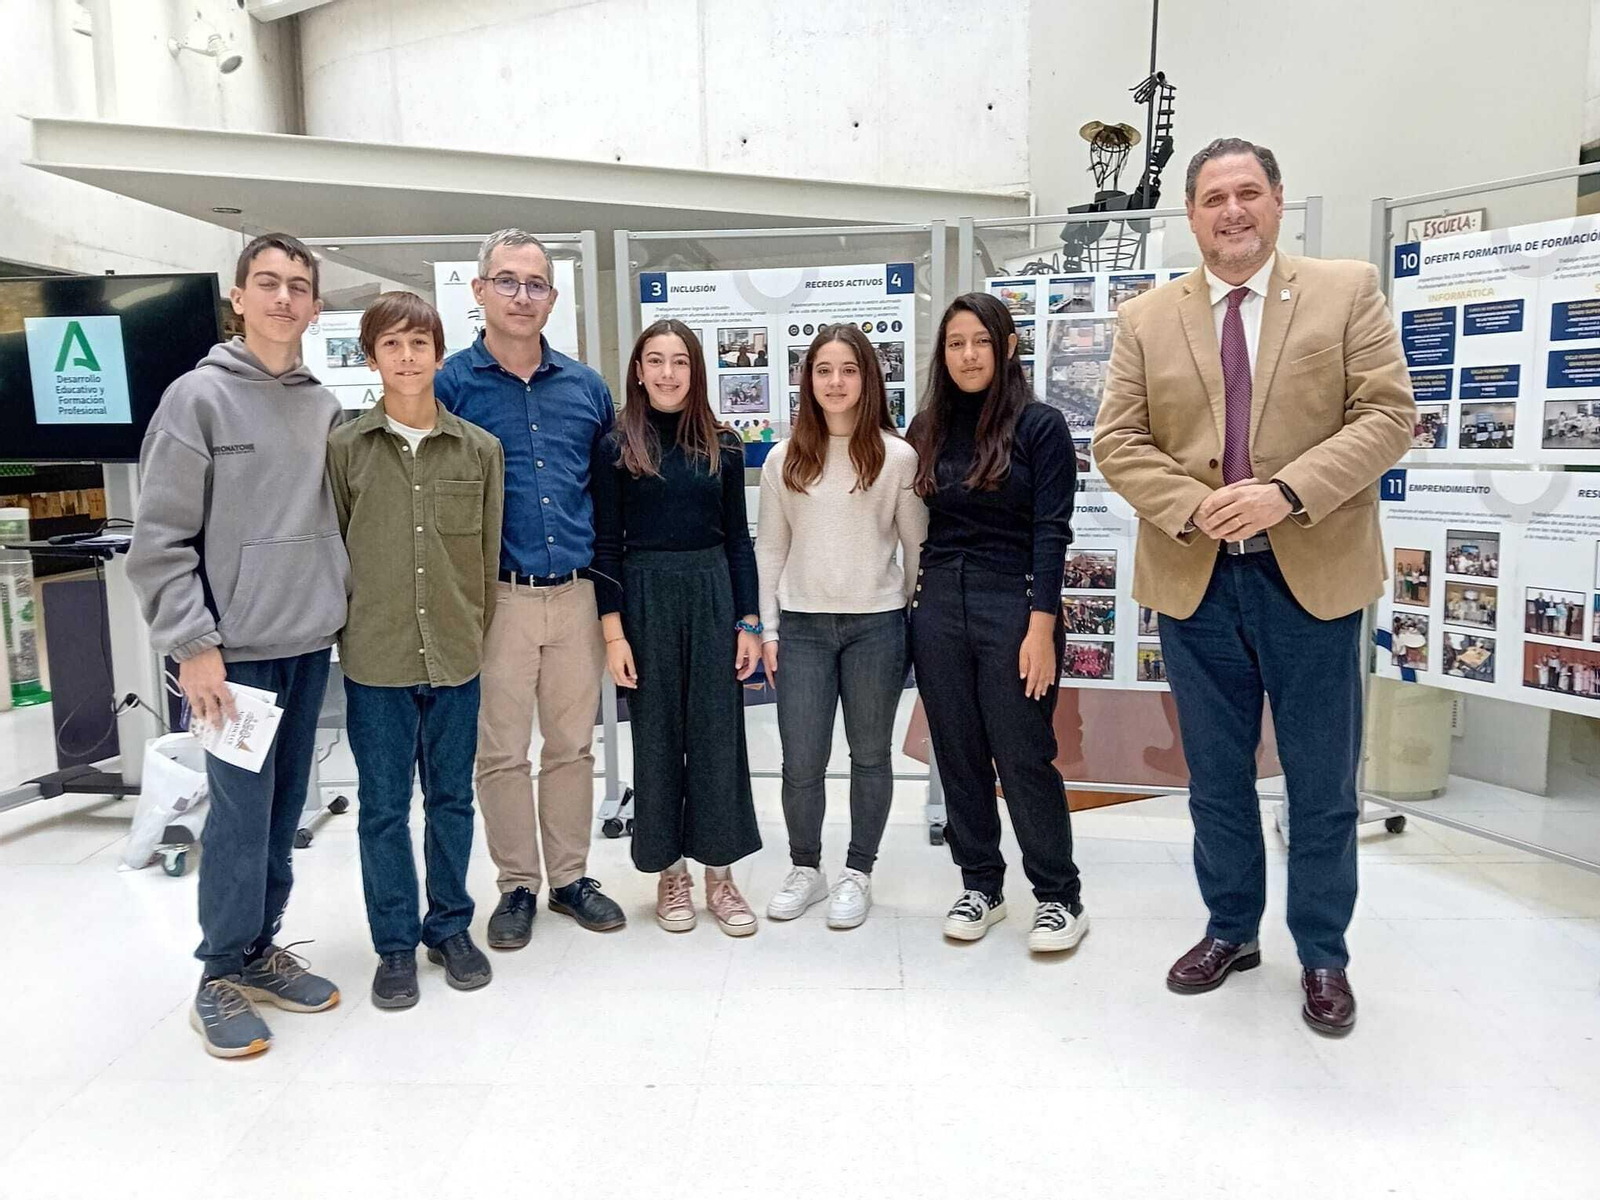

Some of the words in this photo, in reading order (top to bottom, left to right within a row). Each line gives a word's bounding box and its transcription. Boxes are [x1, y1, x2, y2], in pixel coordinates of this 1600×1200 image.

[1423, 216, 1476, 238] ESCUELA:
[1424, 252, 1460, 265] OFERTA
[1463, 243, 1522, 259] FORMATIVA
[1525, 241, 1539, 251] DE
[1401, 253, 1418, 270] 10
[805, 279, 844, 289] RECREOS
[846, 278, 883, 287] ACTIVOS
[891, 273, 902, 287] 4
[651, 282, 661, 296] 3
[670, 283, 716, 293] INCLUSIÓN
[1428, 287, 1494, 302] INFORMÁTICA
[56, 375, 101, 384] Desarrollo
[56, 385, 98, 394] Educativo
[99, 387, 105, 395] y
[58, 395, 105, 404] Formación
[58, 406, 107, 415] Profesional
[1388, 479, 1402, 494] 11
[1409, 484, 1491, 494] EMPRENDIMIENTO
